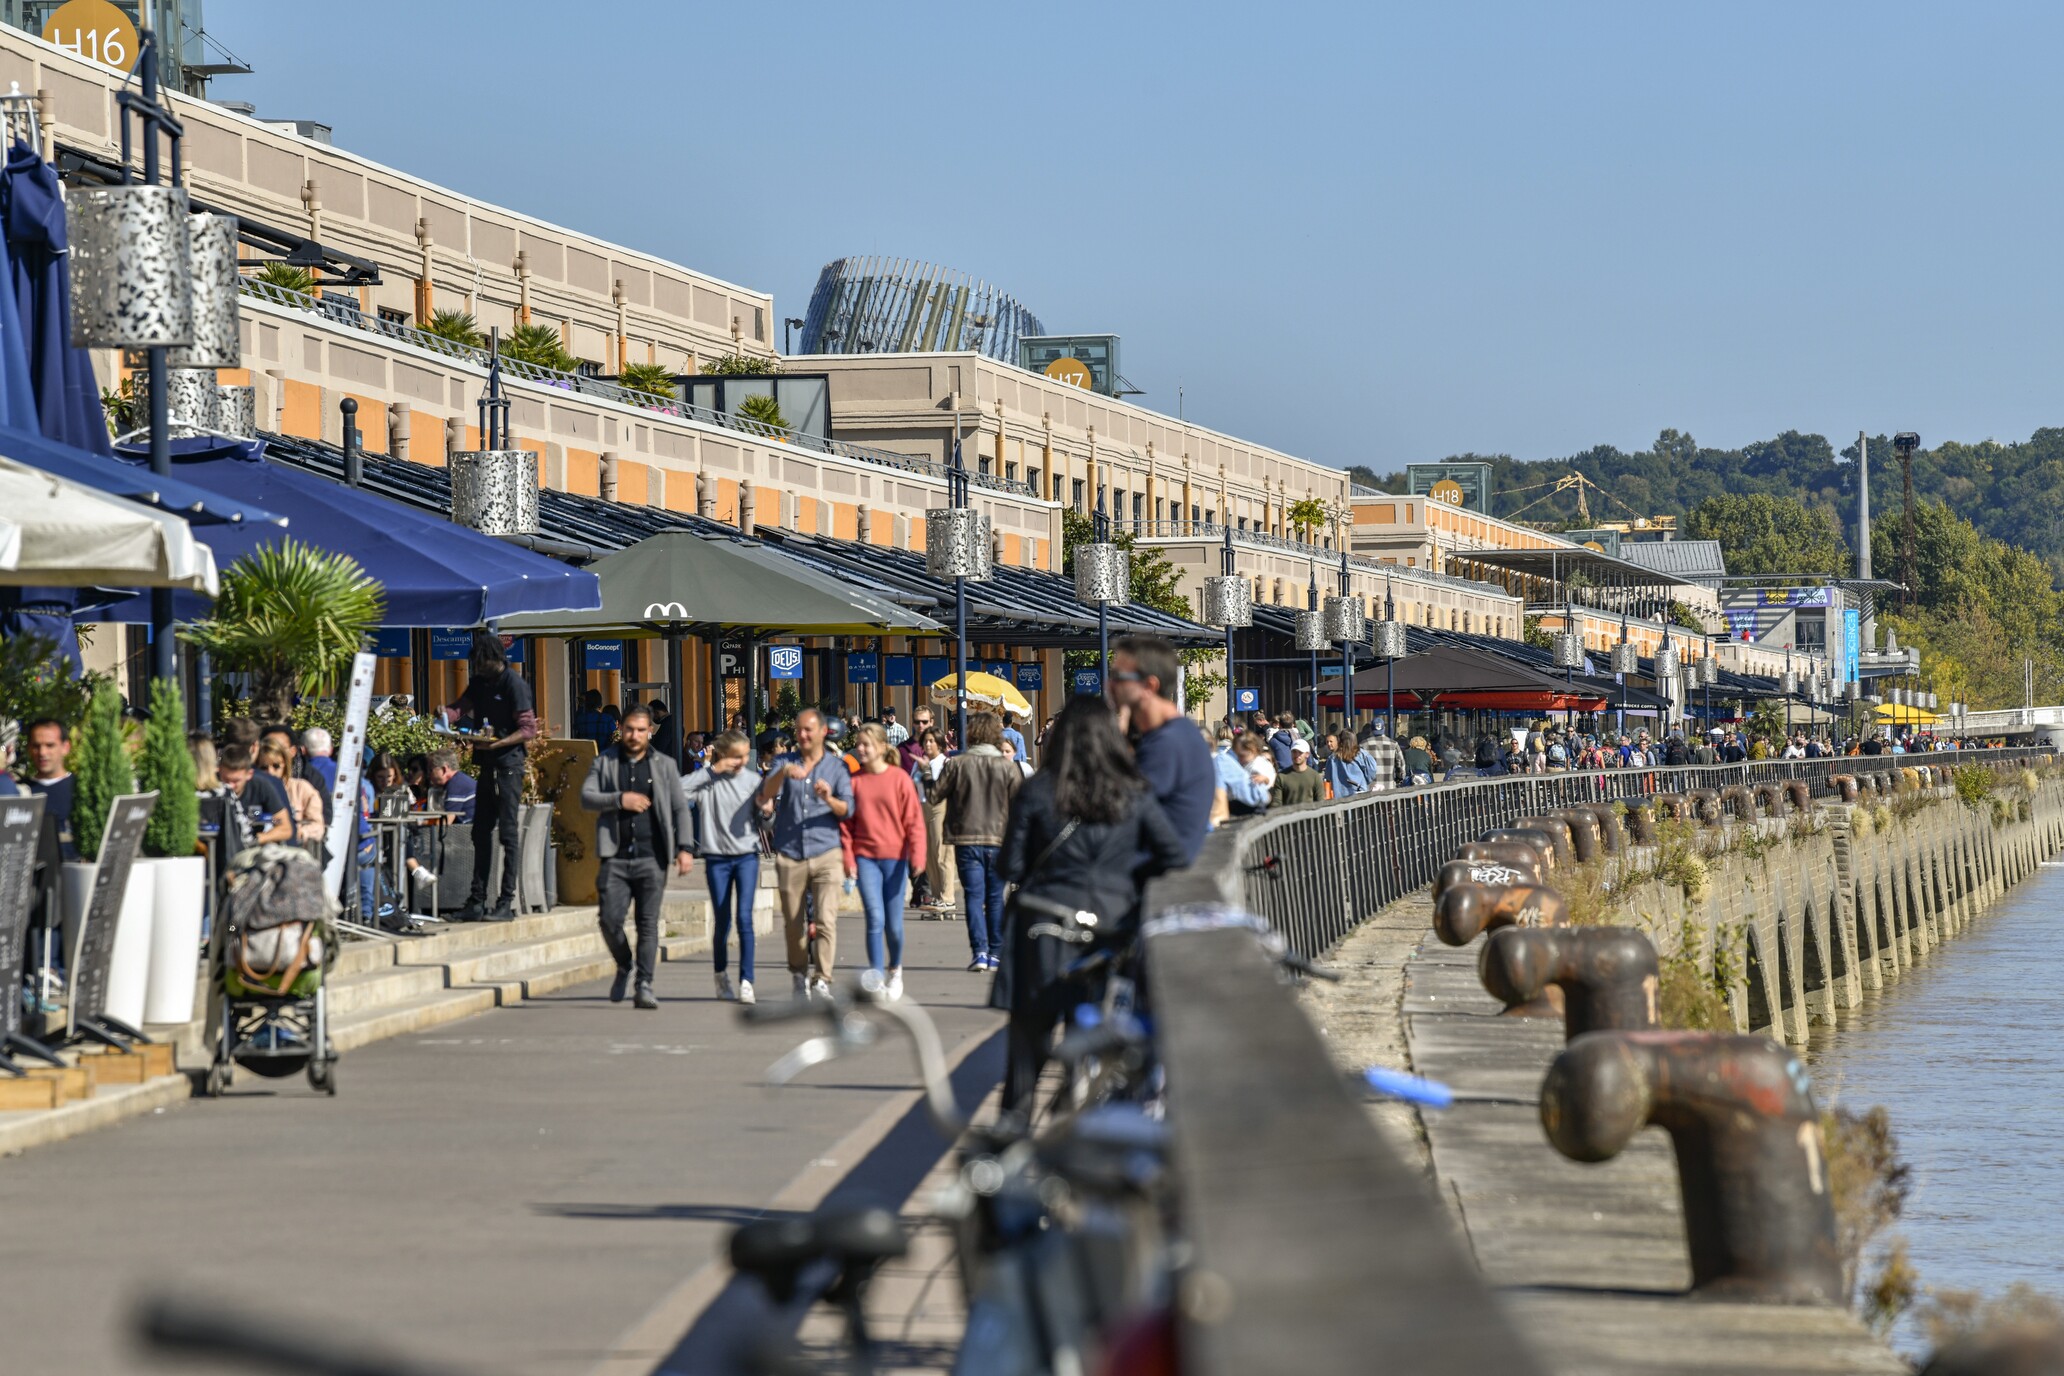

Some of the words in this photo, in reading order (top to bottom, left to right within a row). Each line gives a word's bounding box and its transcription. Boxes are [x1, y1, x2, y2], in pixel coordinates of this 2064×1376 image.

[54, 27, 125, 66] H16
[1048, 373, 1084, 387] 17
[1434, 489, 1459, 503] H18
[433, 635, 471, 644] Descamps
[1848, 612, 1856, 653] SCIENCES
[586, 643, 620, 652] BoConcept
[774, 650, 798, 667] DEUS
